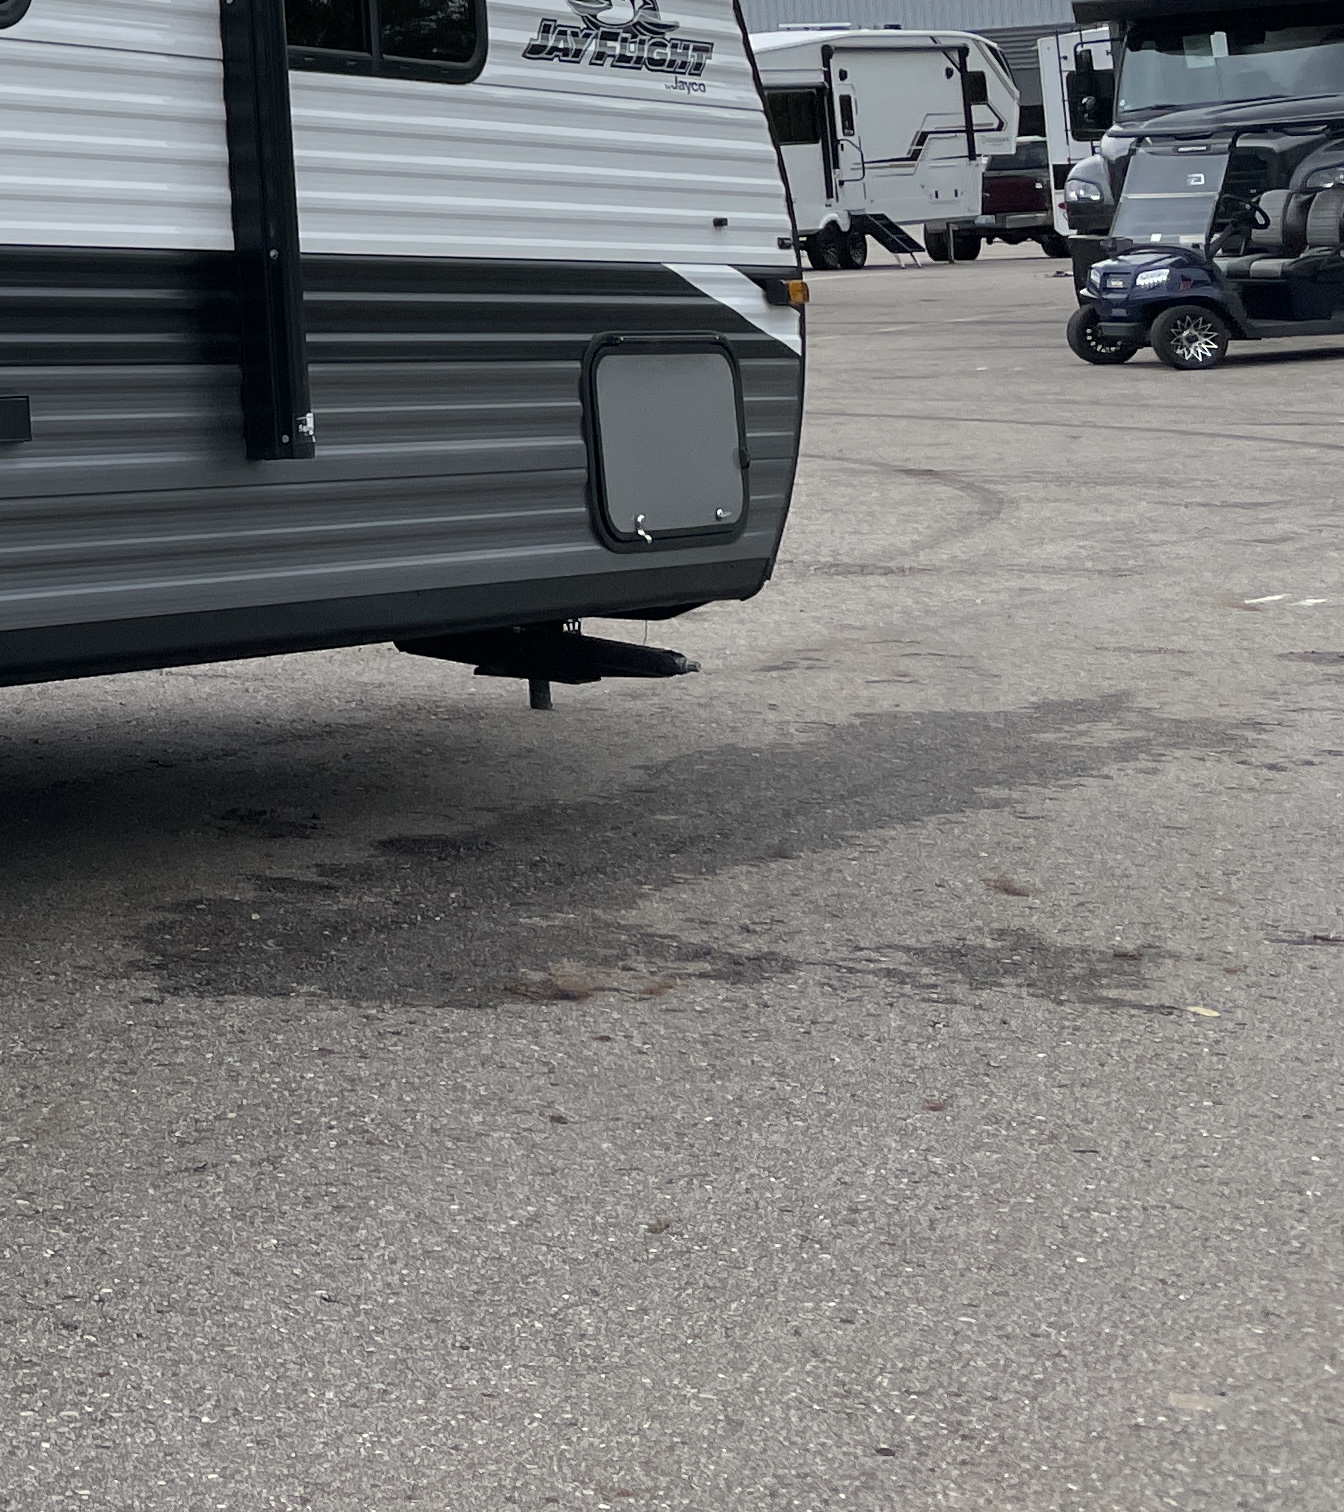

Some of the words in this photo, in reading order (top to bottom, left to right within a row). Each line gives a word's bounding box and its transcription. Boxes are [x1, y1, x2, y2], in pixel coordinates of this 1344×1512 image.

[522, 18, 596, 64] JAY
[589, 27, 714, 77] FLIGHT
[672, 75, 707, 95] Jayco
